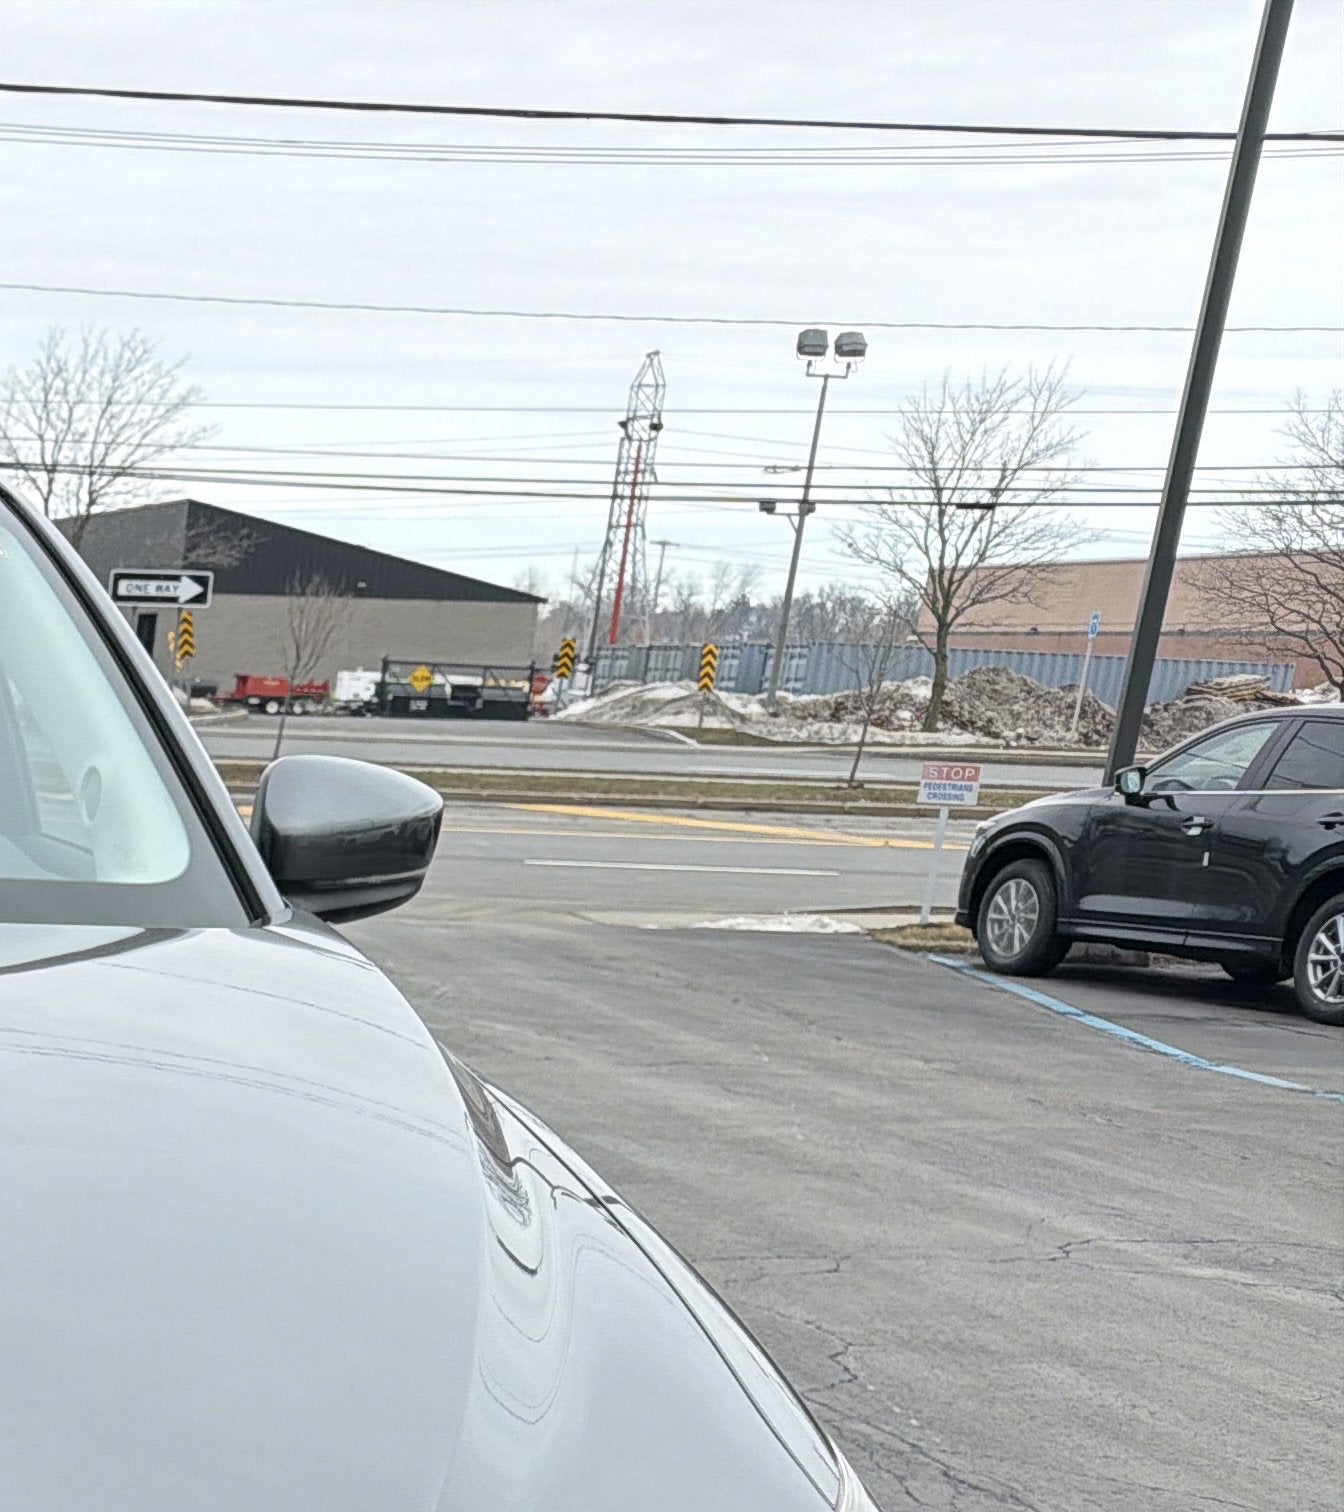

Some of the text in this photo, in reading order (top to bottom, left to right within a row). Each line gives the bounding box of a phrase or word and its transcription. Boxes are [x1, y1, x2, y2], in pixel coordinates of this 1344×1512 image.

[125, 583, 180, 594] ONE WAY
[928, 766, 976, 780] STOP
[926, 792, 965, 802] CROSSING
